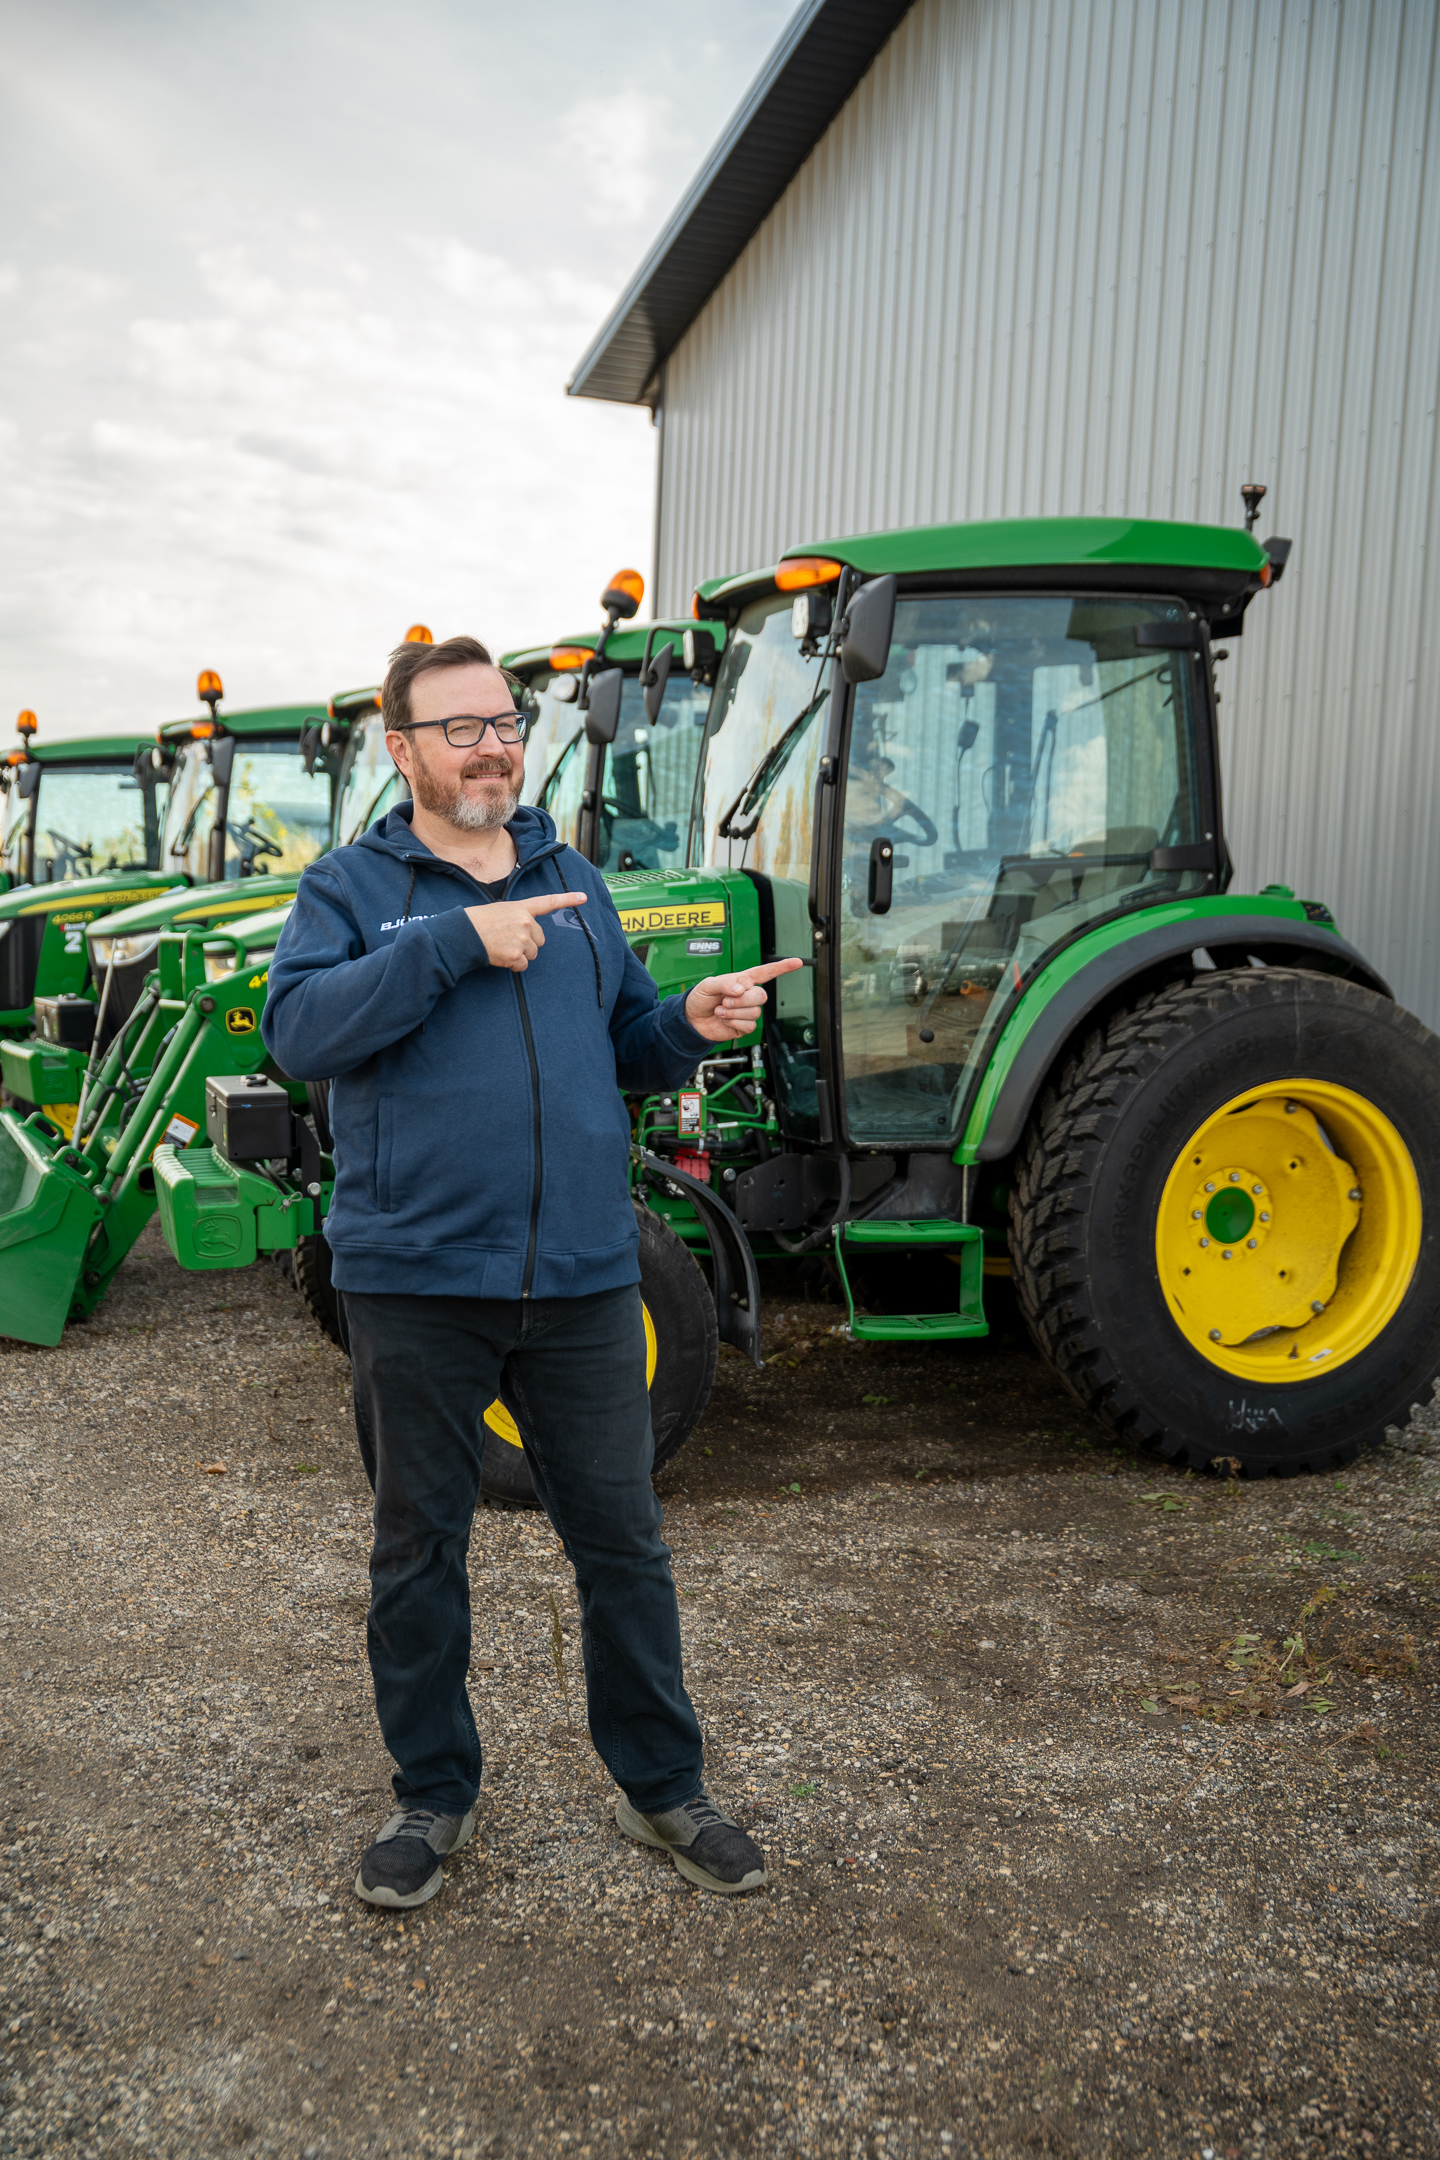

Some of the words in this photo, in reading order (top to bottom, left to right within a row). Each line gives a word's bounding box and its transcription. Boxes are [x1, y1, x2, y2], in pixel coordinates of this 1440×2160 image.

[103, 893, 129, 903] JOHN
[52, 911, 95, 925] 4066R
[621, 916, 645, 929] HN
[649, 911, 711, 928] DEERE
[64, 931, 82, 953] 2
[689, 942, 720, 950] ENNS
[1110, 1058, 1216, 1260] HAKKAPELIITTA
